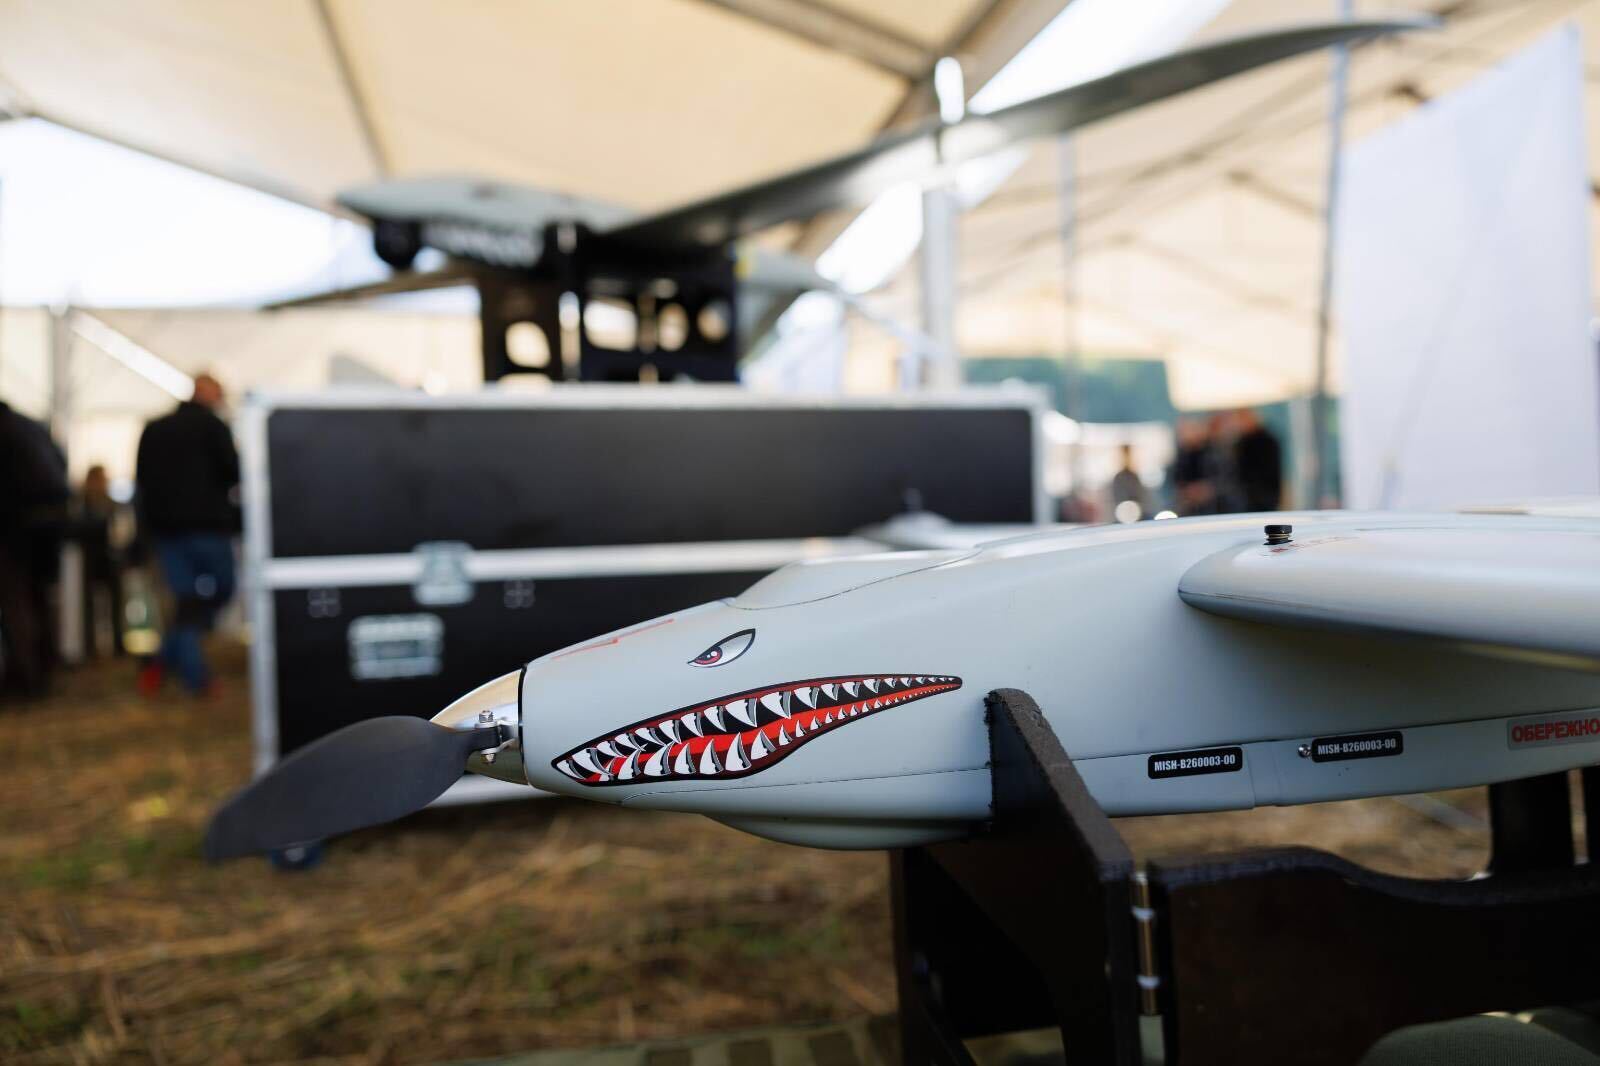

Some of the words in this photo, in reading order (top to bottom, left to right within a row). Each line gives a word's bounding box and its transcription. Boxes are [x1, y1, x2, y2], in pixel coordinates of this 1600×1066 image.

[1511, 718, 1600, 742] ОБЕРЕЖНО
[1317, 738, 1396, 756] MISH-B260003-00
[1154, 754, 1236, 772] MISH-B260003-00
